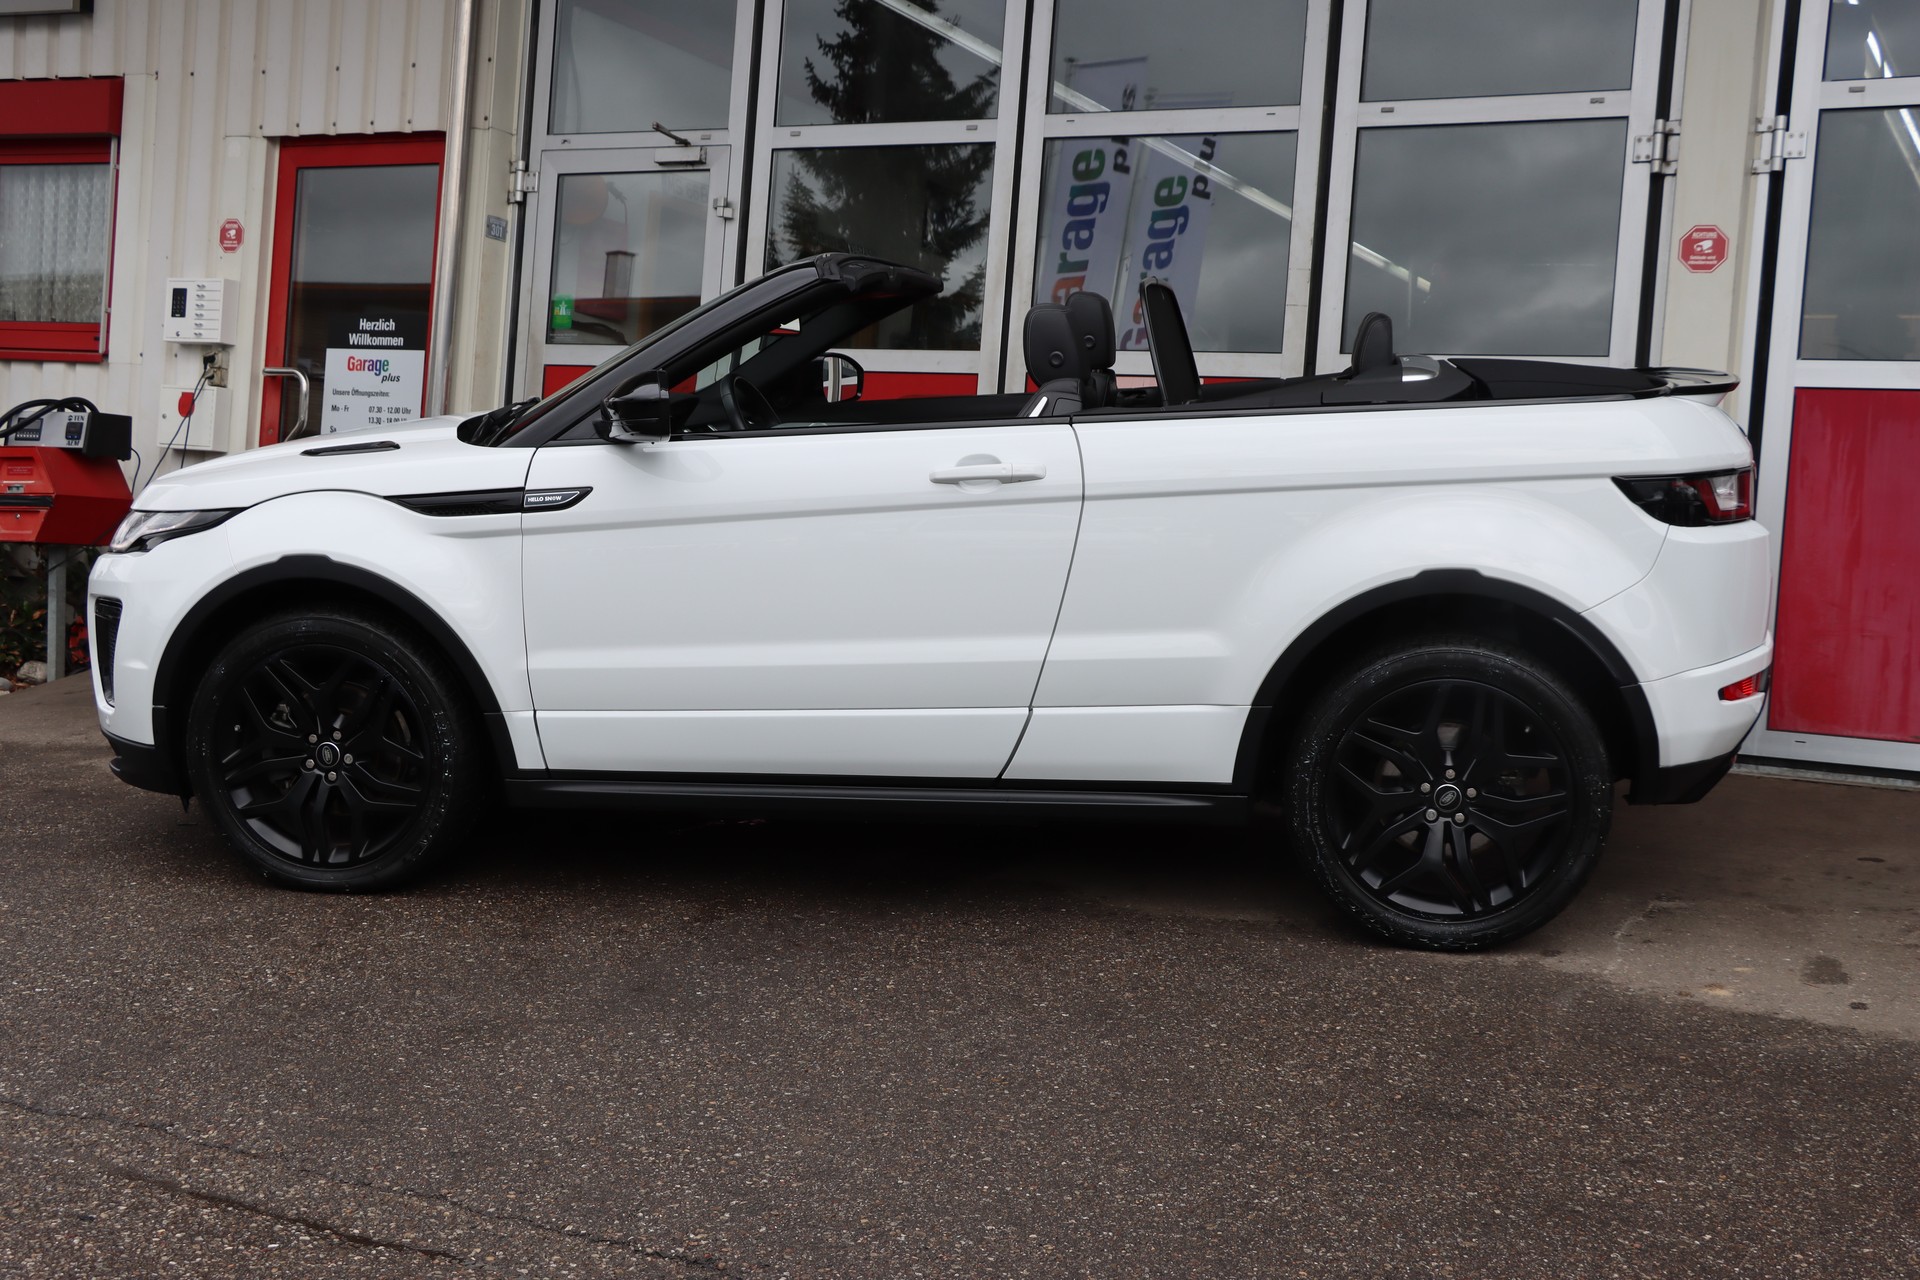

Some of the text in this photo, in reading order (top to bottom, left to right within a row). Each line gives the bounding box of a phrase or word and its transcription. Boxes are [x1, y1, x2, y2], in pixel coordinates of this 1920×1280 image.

[490, 224, 502, 238] 301
[1050, 148, 1110, 305] arage
[359, 318, 396, 331] Herzlich
[348, 333, 404, 346] Willkommen
[347, 356, 390, 376] Garage
[381, 373, 401, 384] plus
[332, 388, 351, 396] Unsere
[331, 404, 340, 412] Mo
[368, 406, 383, 414] 07.30
[387, 406, 401, 414] 12.00
[401, 406, 412, 415] Uhr
